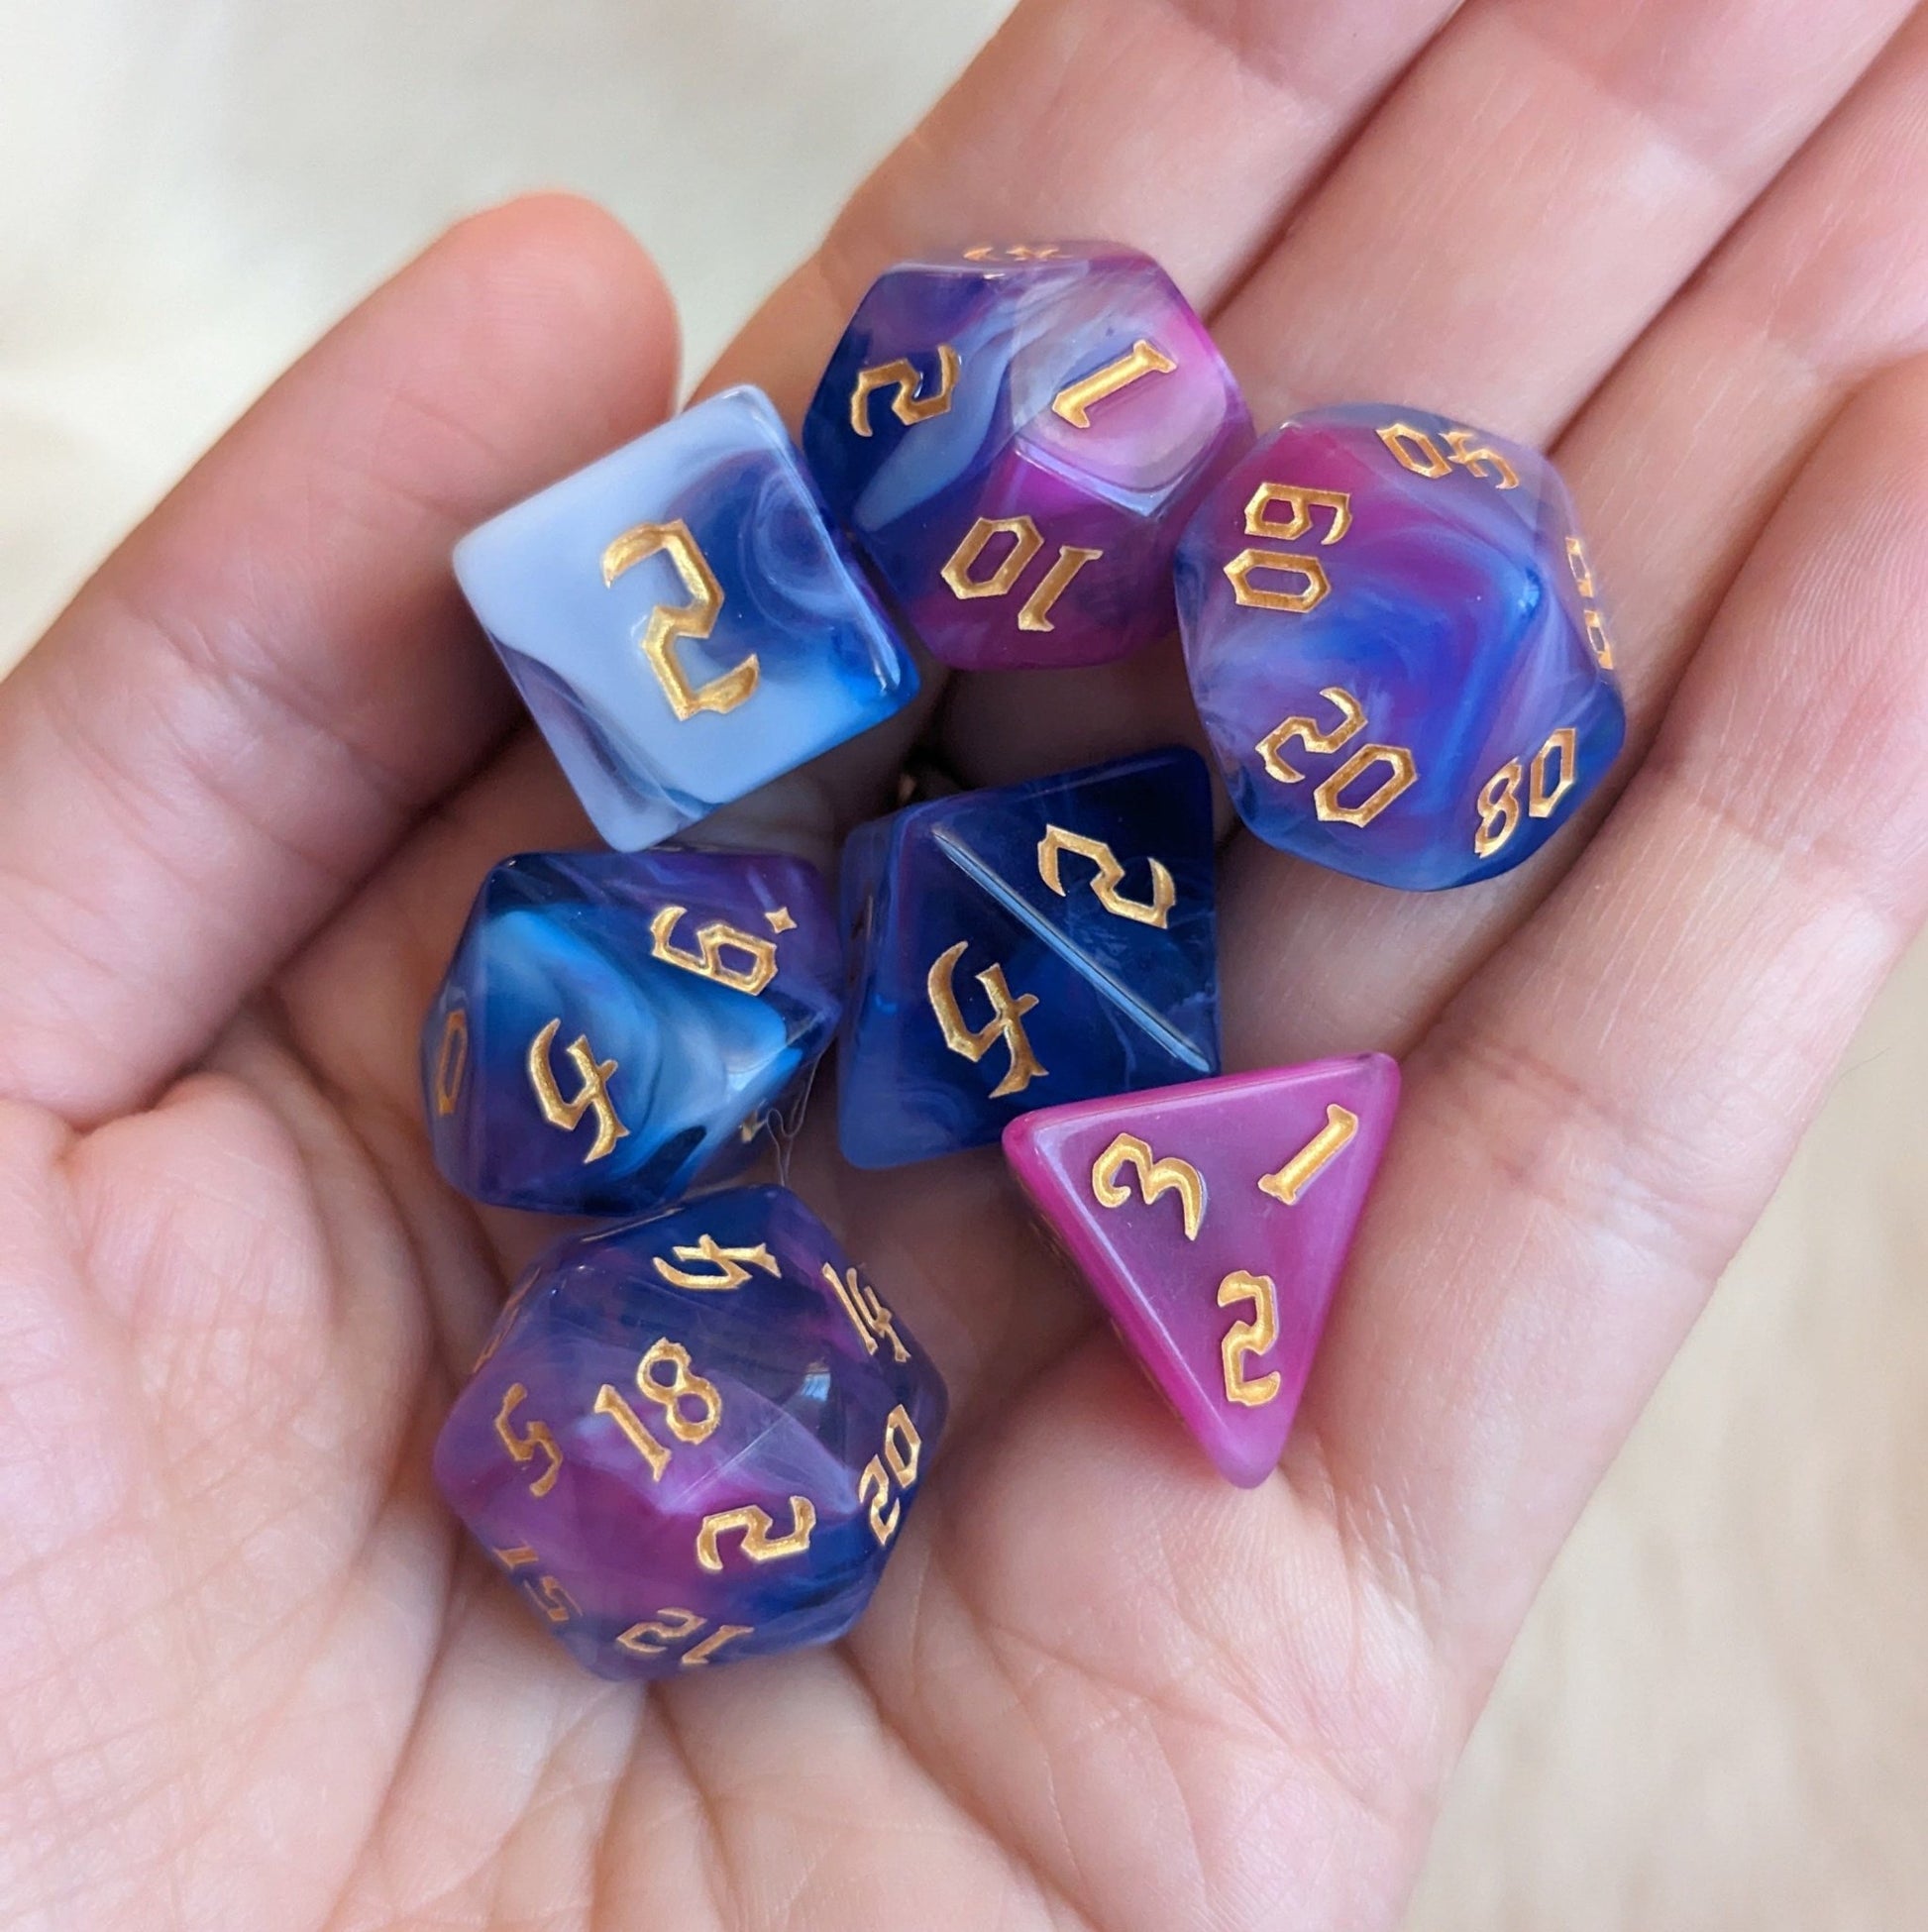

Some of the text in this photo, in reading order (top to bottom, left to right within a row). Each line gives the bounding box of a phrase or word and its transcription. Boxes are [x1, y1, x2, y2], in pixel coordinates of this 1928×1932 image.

[849, 344, 961, 437] 2
[1052, 339, 1177, 429] 1
[1375, 423, 1519, 489] 40
[600, 517, 760, 722] 2
[940, 514, 1105, 632] 10
[1254, 686, 1419, 829] 20
[1474, 727, 1577, 858] 80
[1036, 822, 1176, 929] 2
[926, 940, 1049, 1100] 4
[527, 1018, 631, 1164] 4
[1092, 1131, 1204, 1241] 3
[1257, 1103, 1359, 1207] 1
[653, 1234, 782, 1289] 4
[821, 1261, 911, 1362] 14
[1217, 1268, 1281, 1407] 2
[494, 1382, 563, 1498] 5
[593, 1337, 722, 1482] 18
[858, 1403, 922, 1546] 20
[696, 1495, 816, 1571] 2
[615, 1607, 755, 1664] 12
